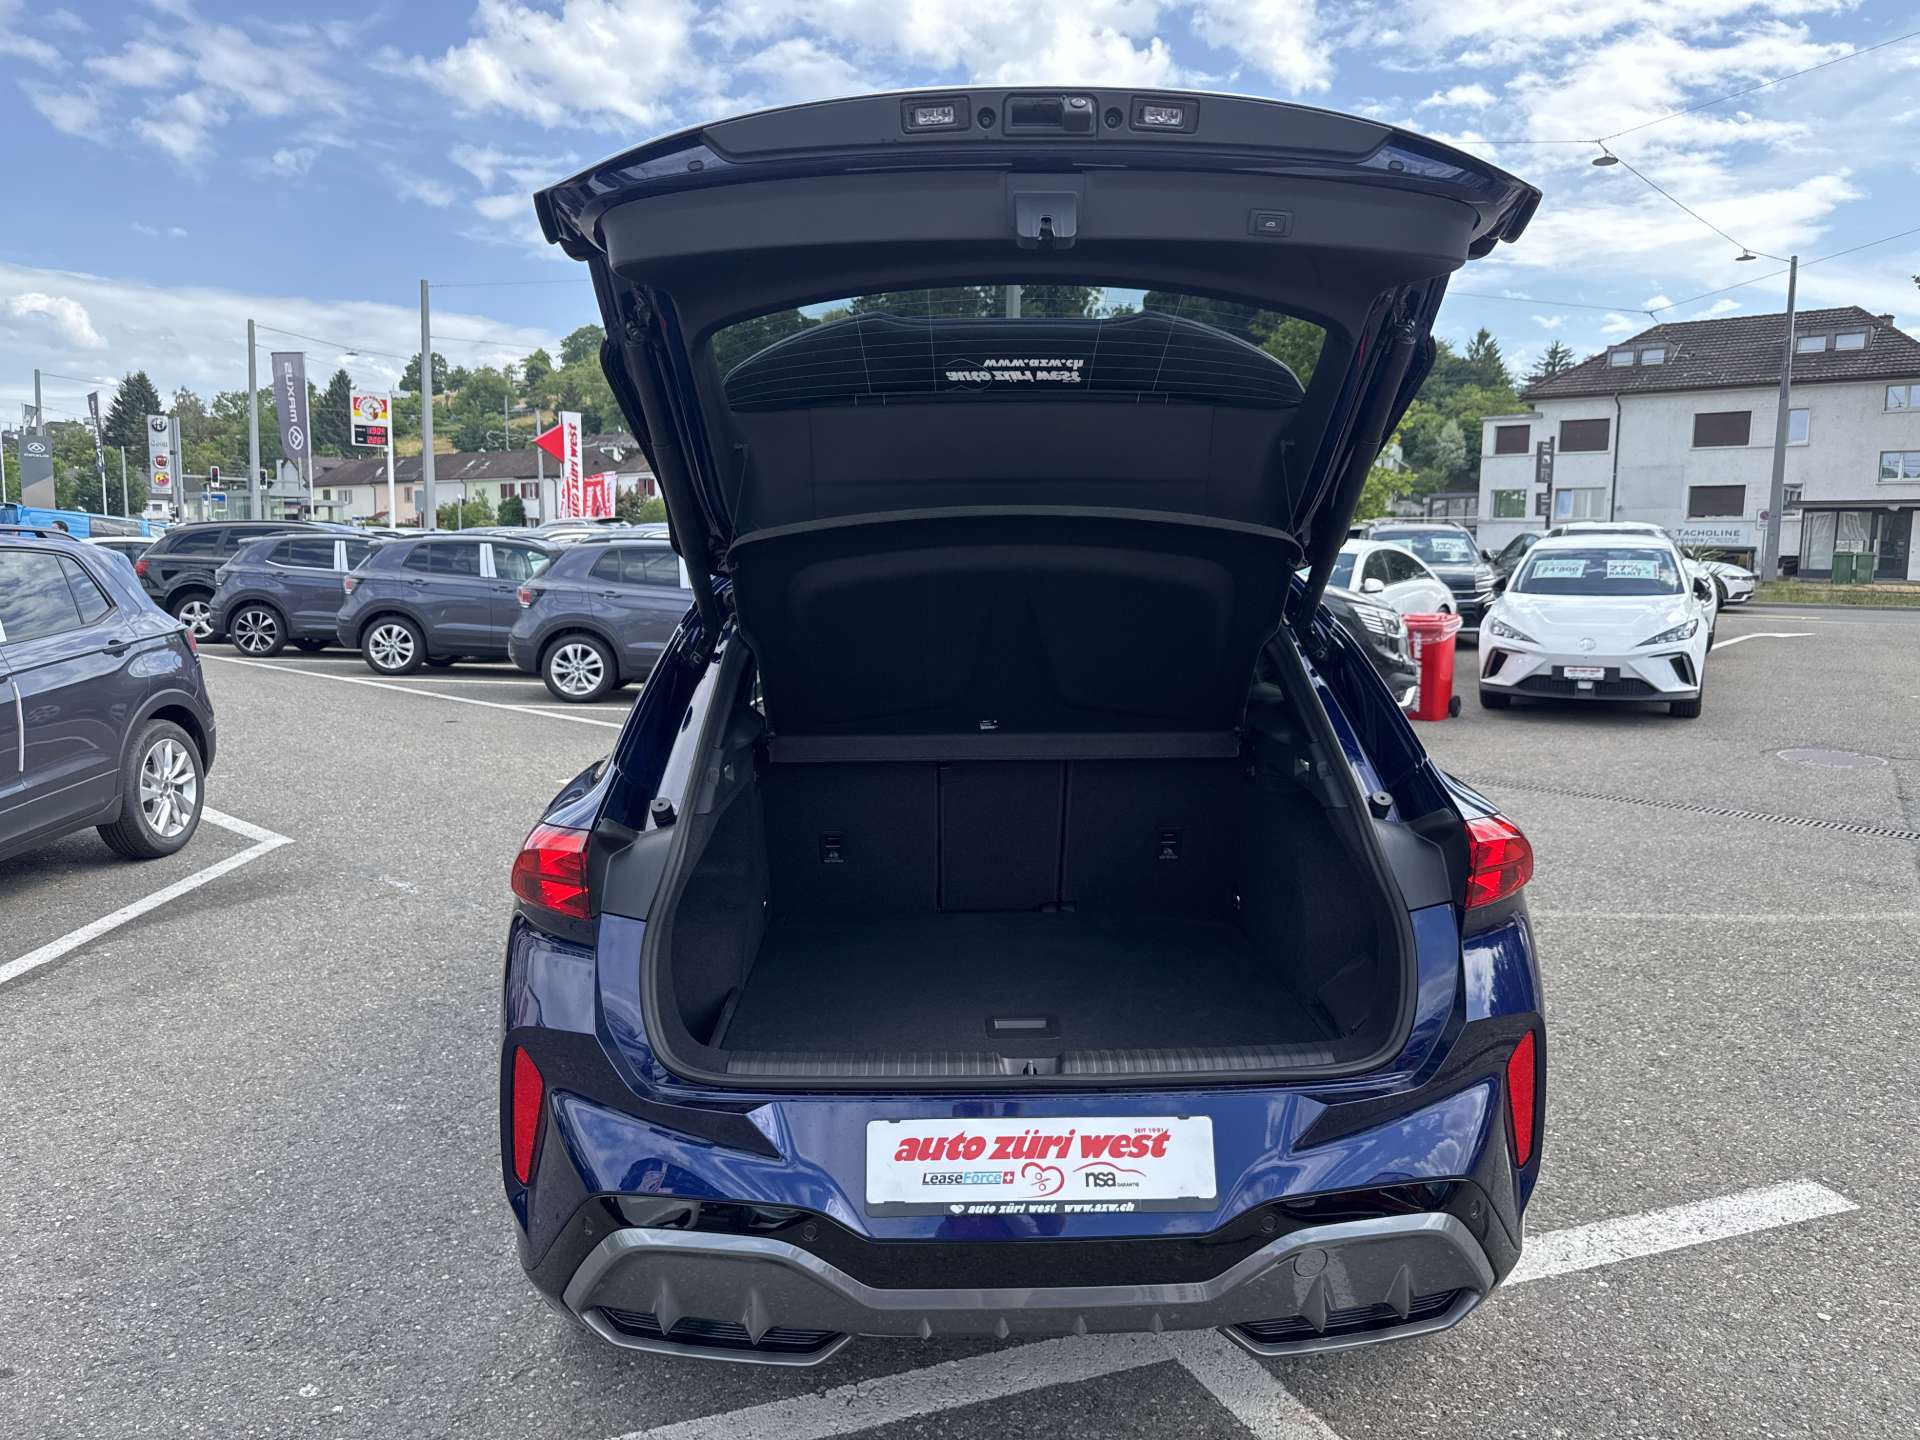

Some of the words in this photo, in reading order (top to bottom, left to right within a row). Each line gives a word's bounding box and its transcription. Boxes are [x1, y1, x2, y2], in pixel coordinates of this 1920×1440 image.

[570, 492, 579, 518] uto
[894, 1130, 987, 1161] auto
[988, 1129, 1076, 1160] züri
[1080, 1129, 1171, 1159] west
[922, 1171, 1003, 1185] LeaseForce
[1085, 1171, 1116, 1188] nsa
[967, 1203, 995, 1214] auto
[1028, 1203, 1057, 1214] west
